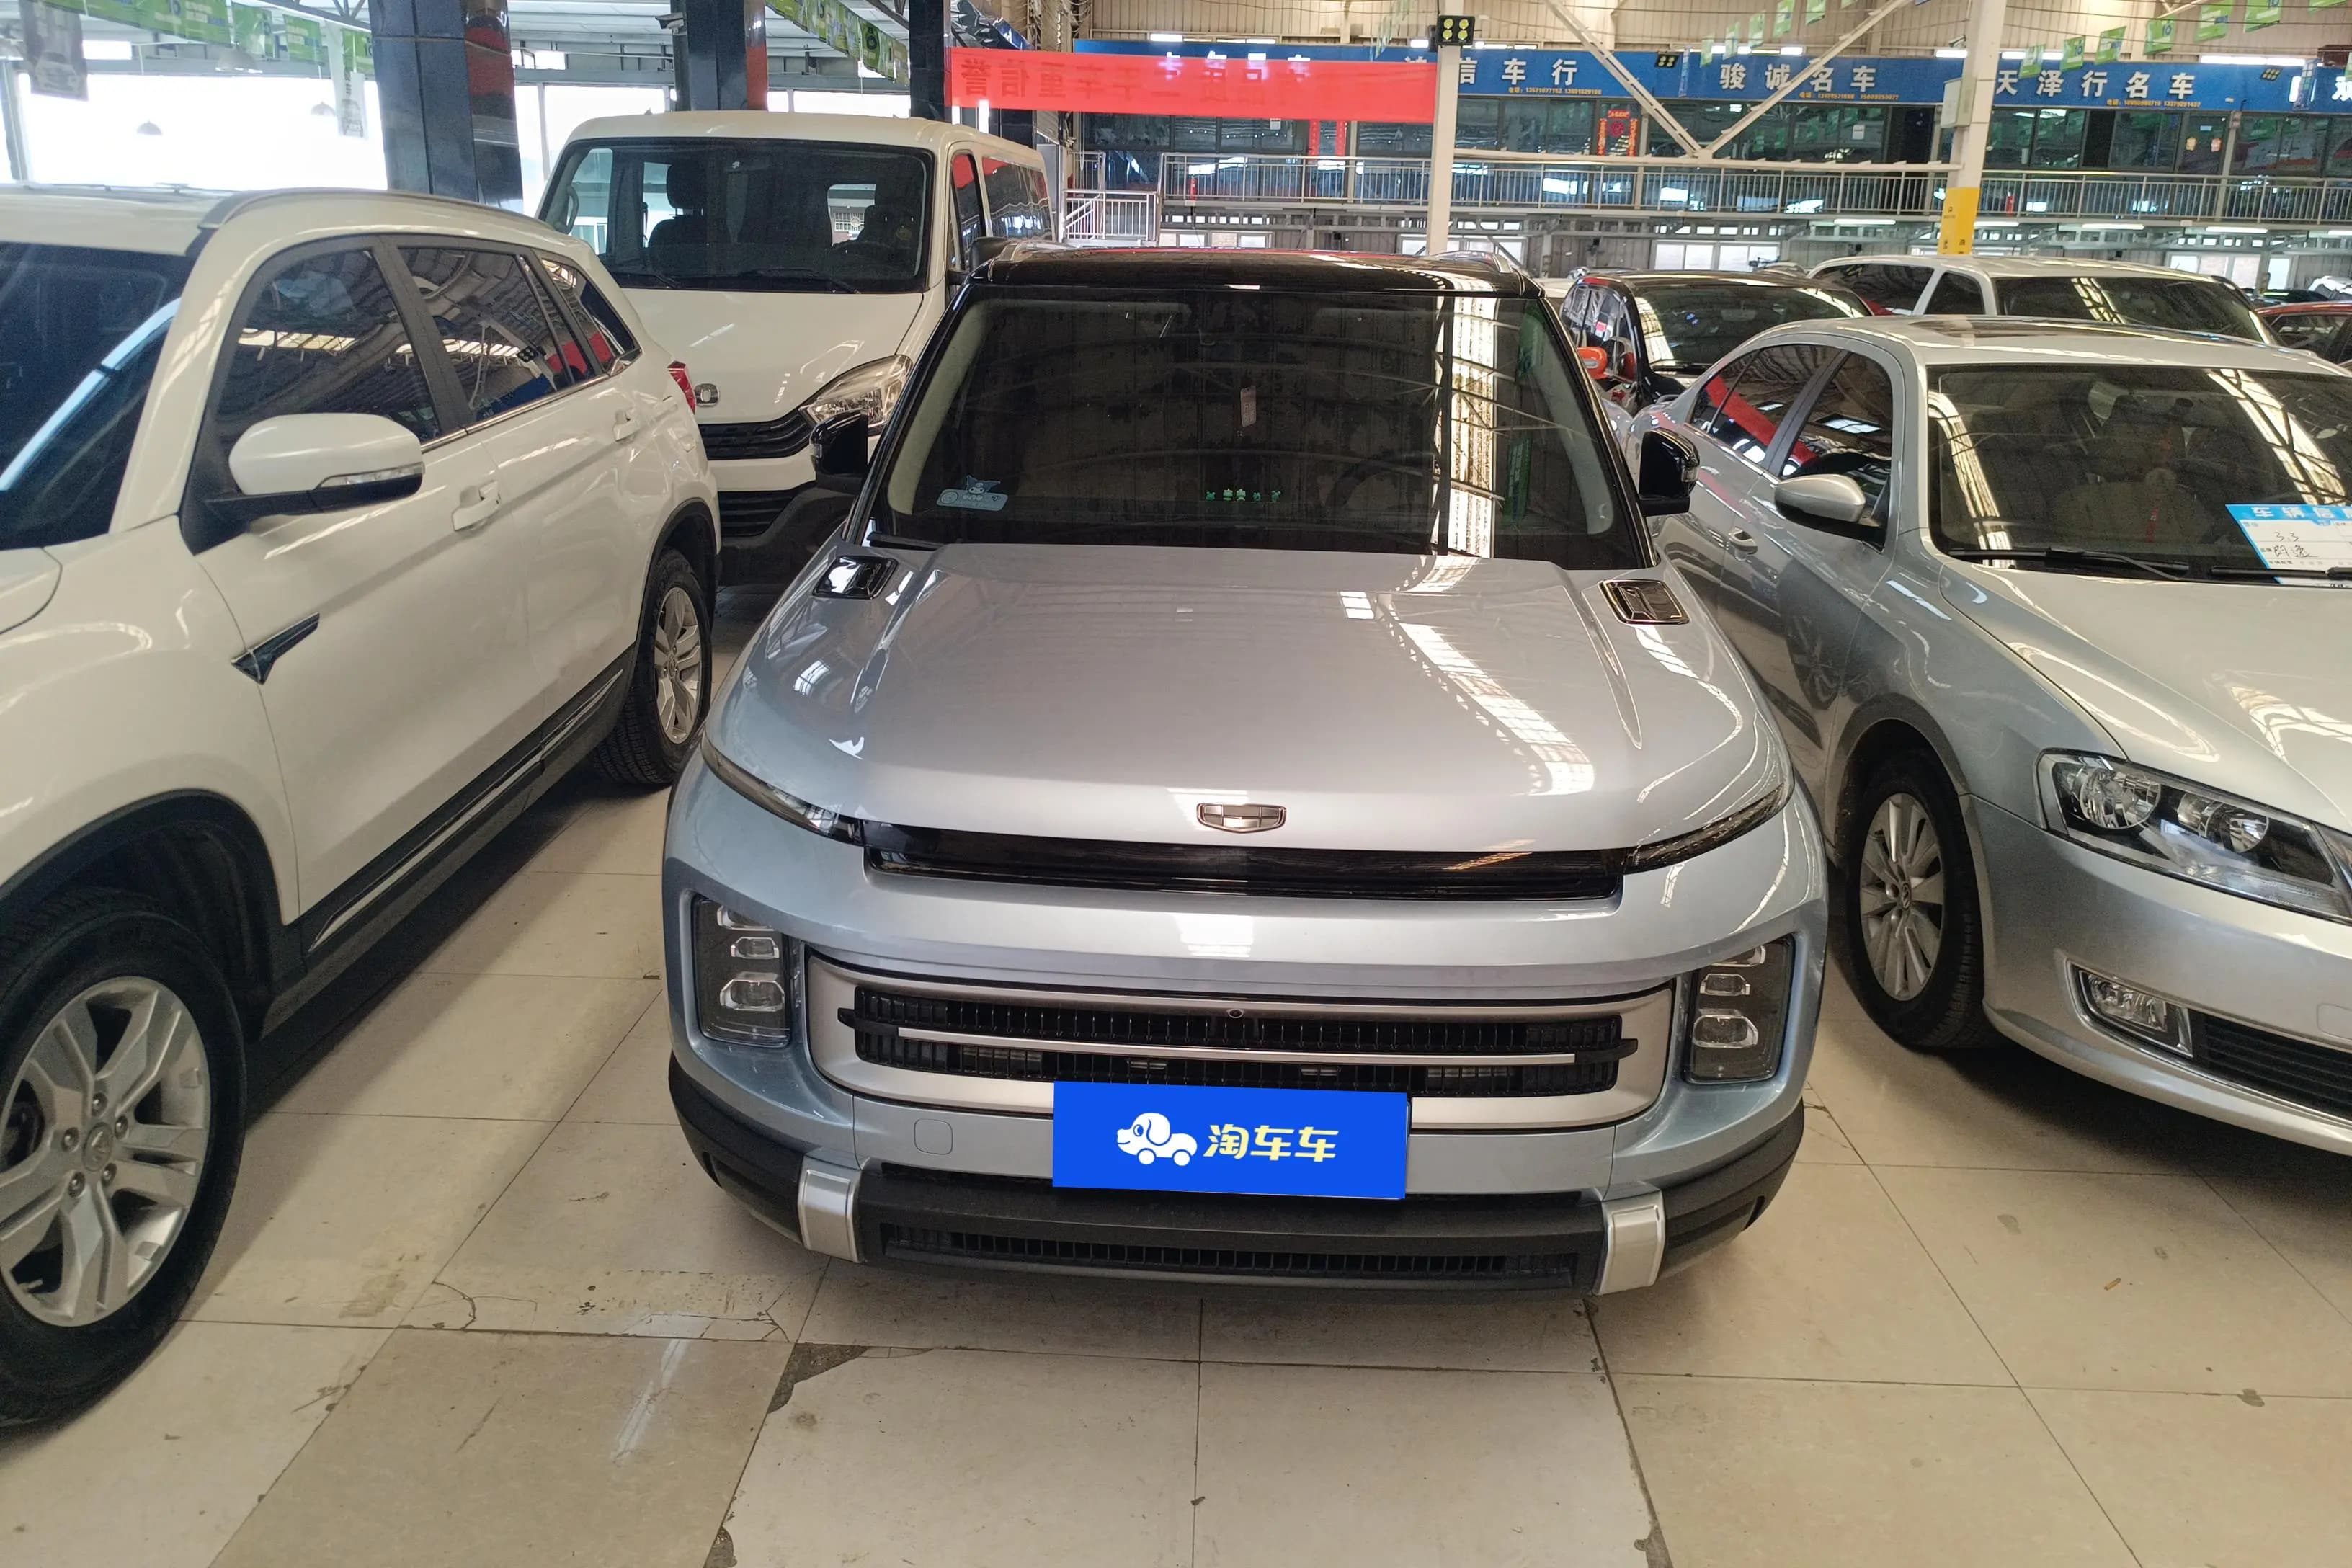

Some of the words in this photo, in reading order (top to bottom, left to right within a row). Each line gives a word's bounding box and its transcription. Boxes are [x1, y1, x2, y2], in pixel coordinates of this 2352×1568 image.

[1404, 56, 1578, 86] 信车行
[1719, 63, 1876, 92] 骏诚名车
[1995, 70, 2195, 99] 天泽行名车
